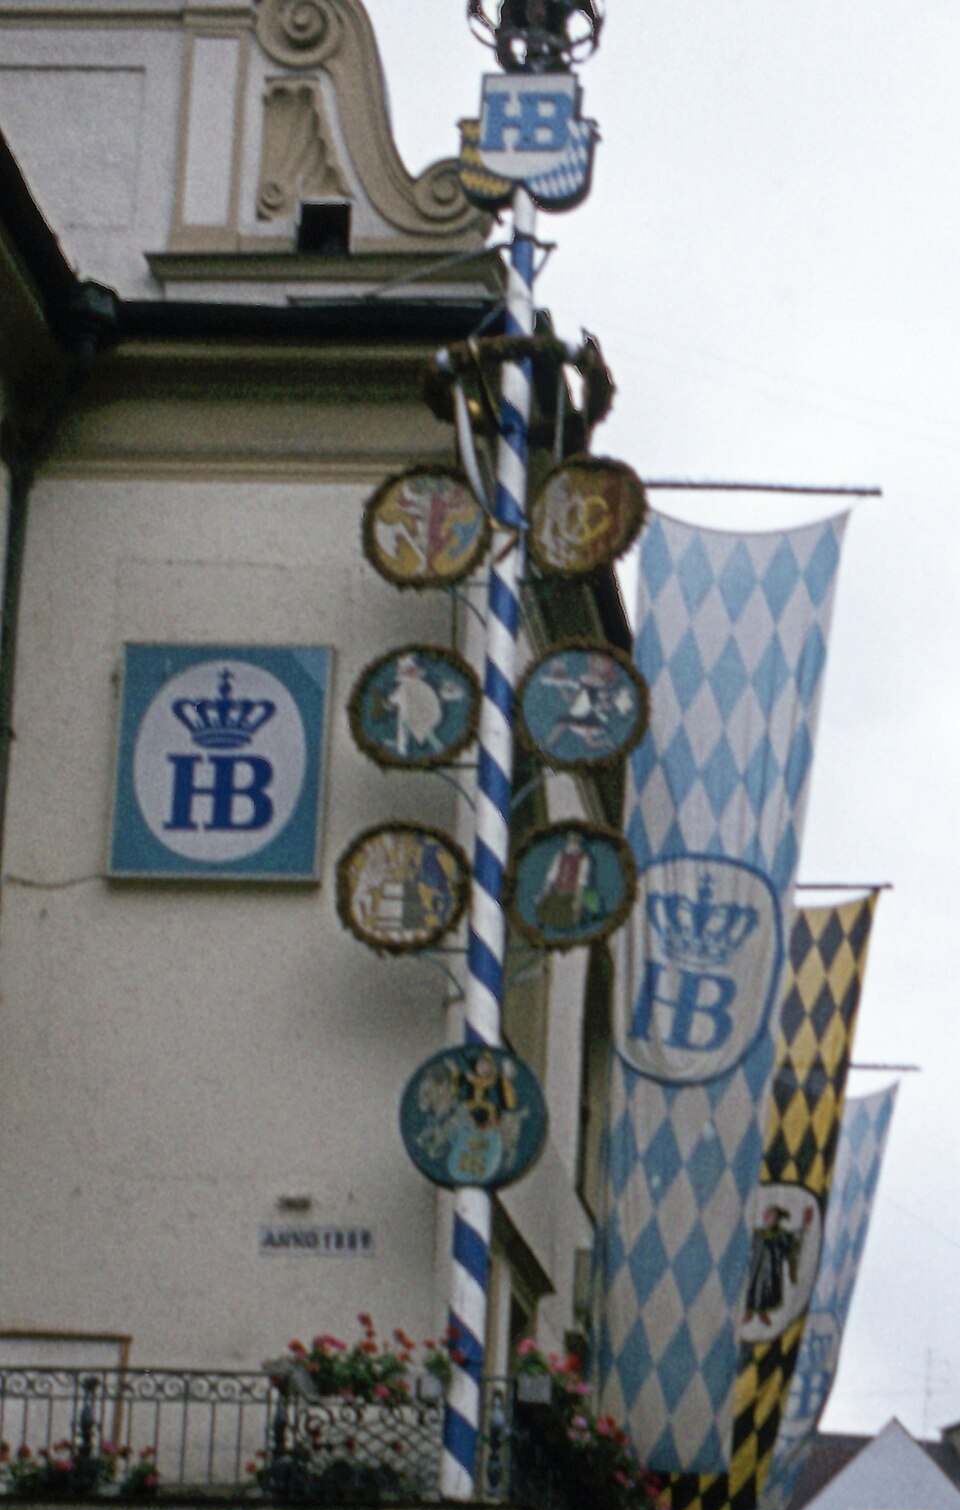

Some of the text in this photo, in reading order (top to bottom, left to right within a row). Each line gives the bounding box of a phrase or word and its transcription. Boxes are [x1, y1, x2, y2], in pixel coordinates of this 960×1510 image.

[479, 92, 573, 152] HB
[163, 754, 274, 831] HB
[628, 960, 738, 1051] HB
[262, 1231, 318, 1248] ANNO
